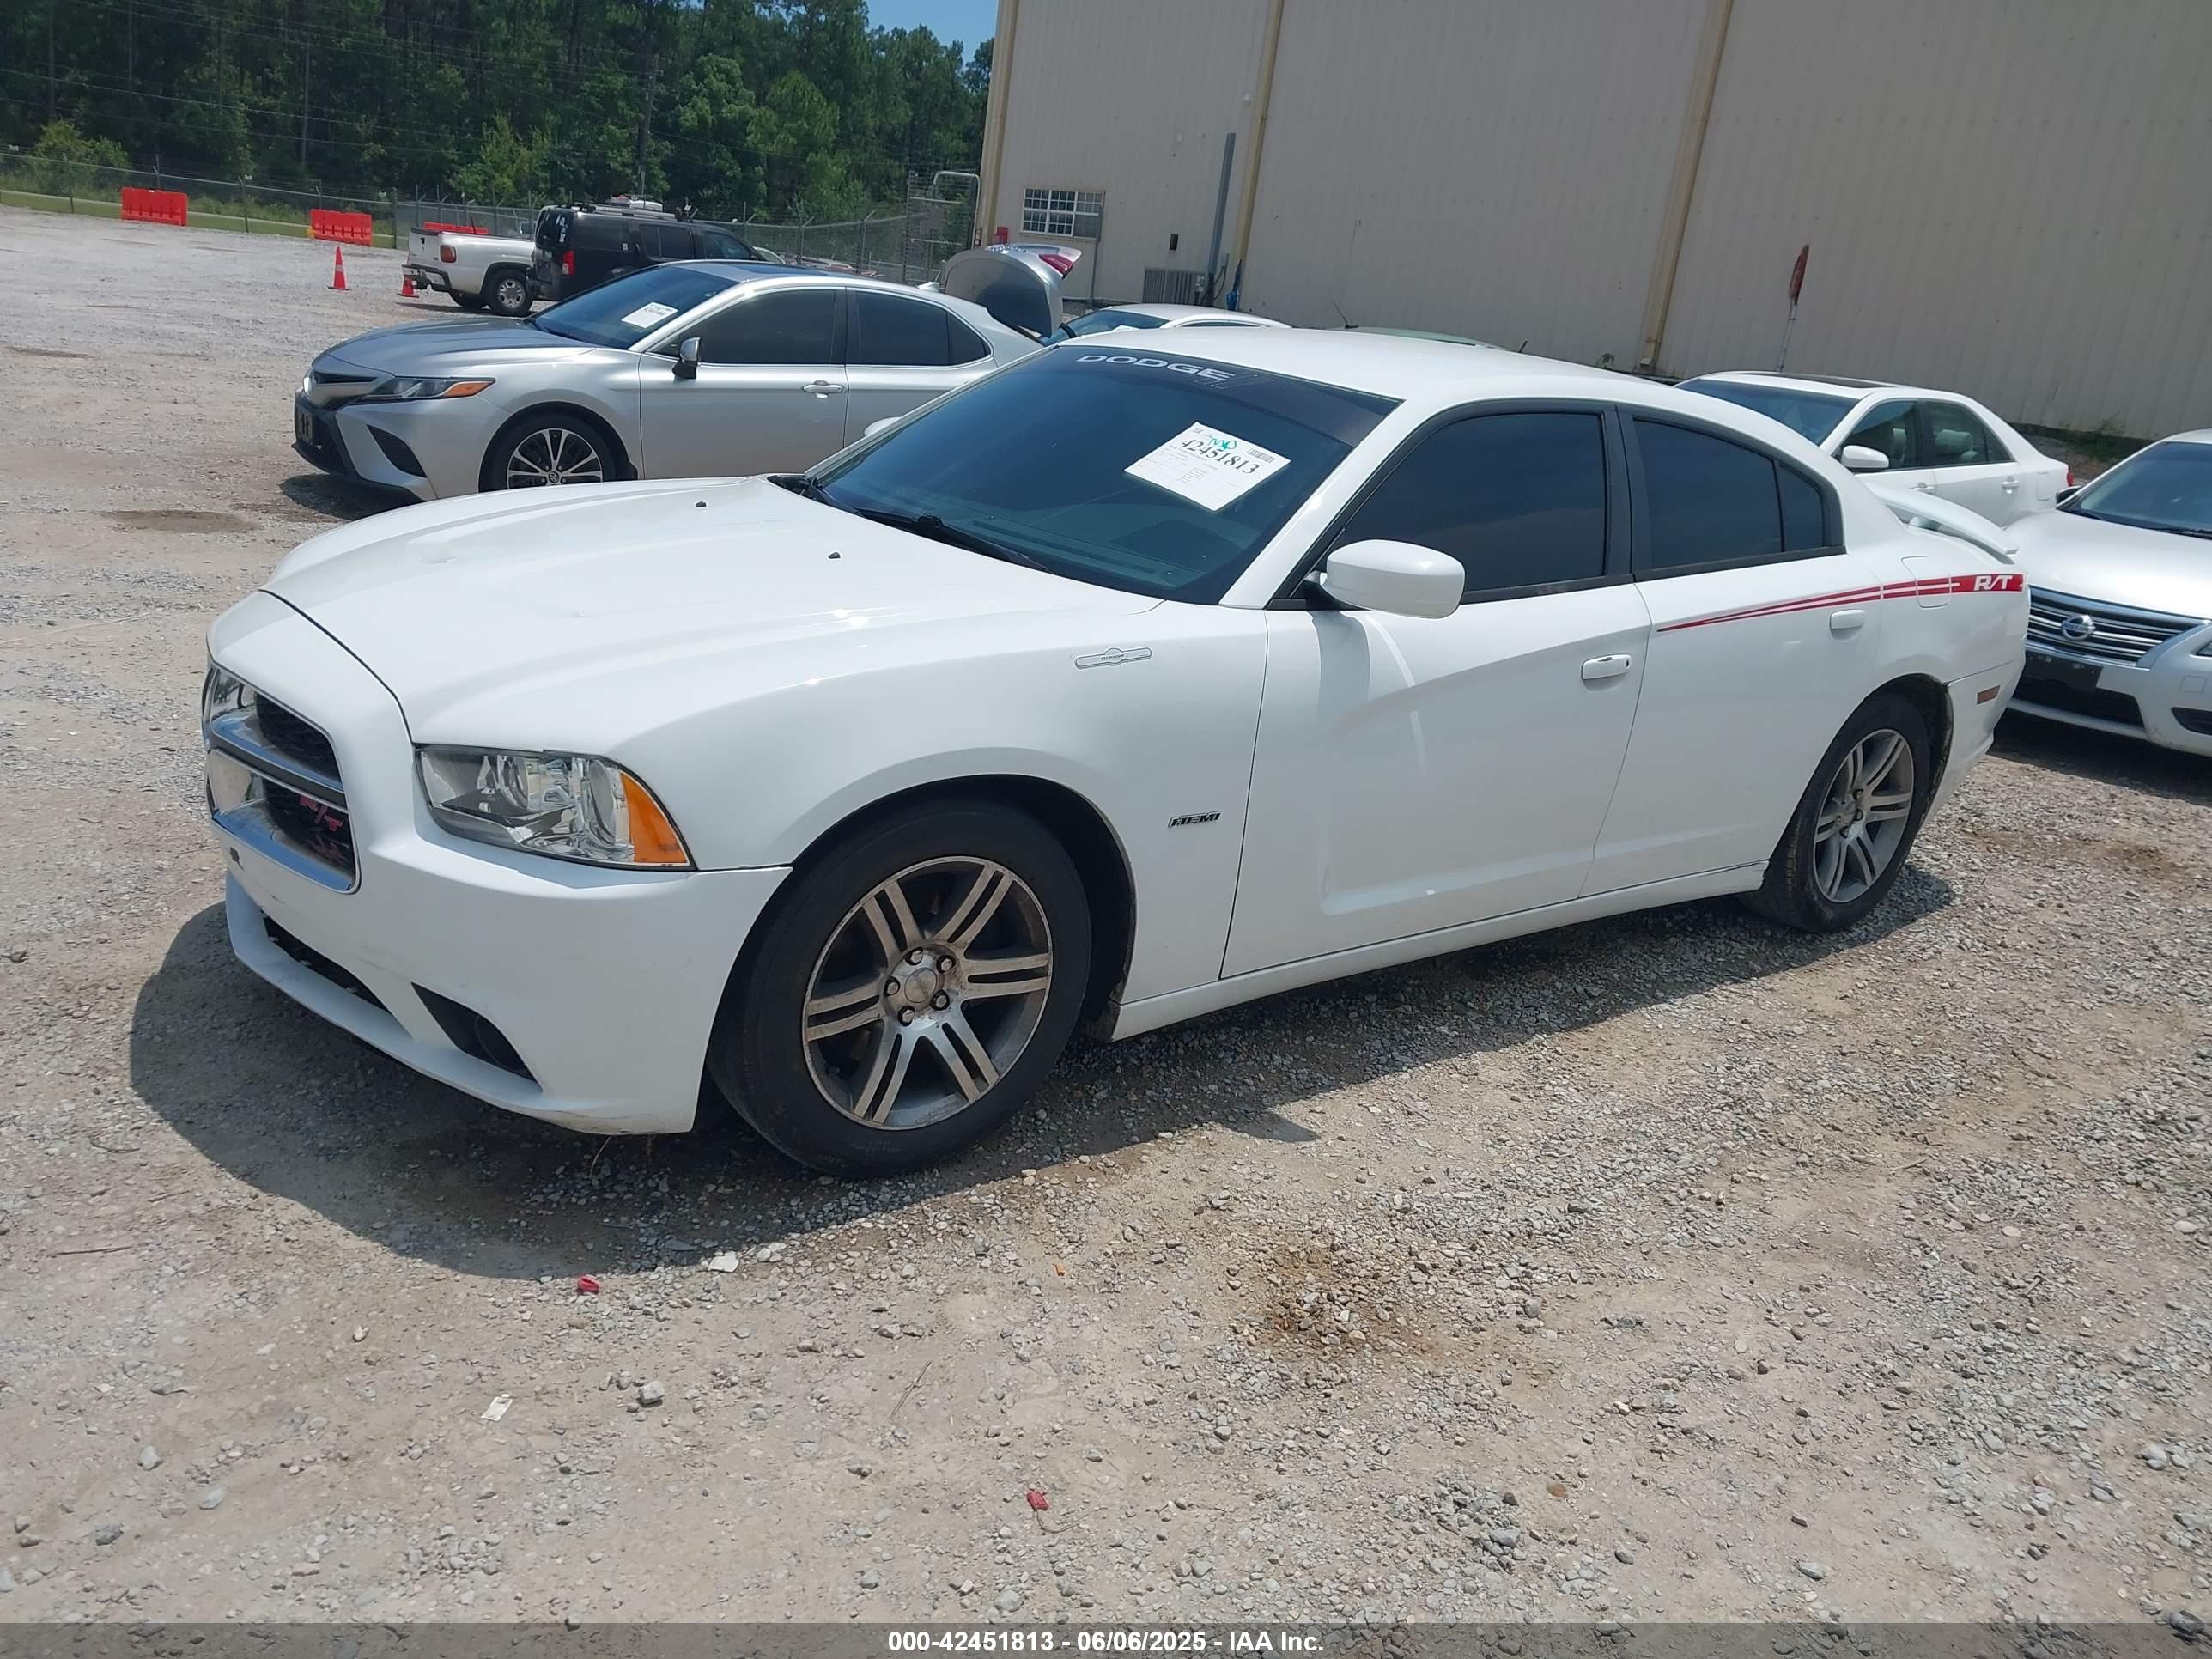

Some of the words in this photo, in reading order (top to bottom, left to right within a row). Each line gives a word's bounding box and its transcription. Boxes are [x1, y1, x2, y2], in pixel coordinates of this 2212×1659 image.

[1076, 355, 1236, 381] DODGE
[1182, 439, 1261, 474] 42451813
[1974, 575, 2013, 591] R/T
[1169, 811, 1221, 827] HEMI
